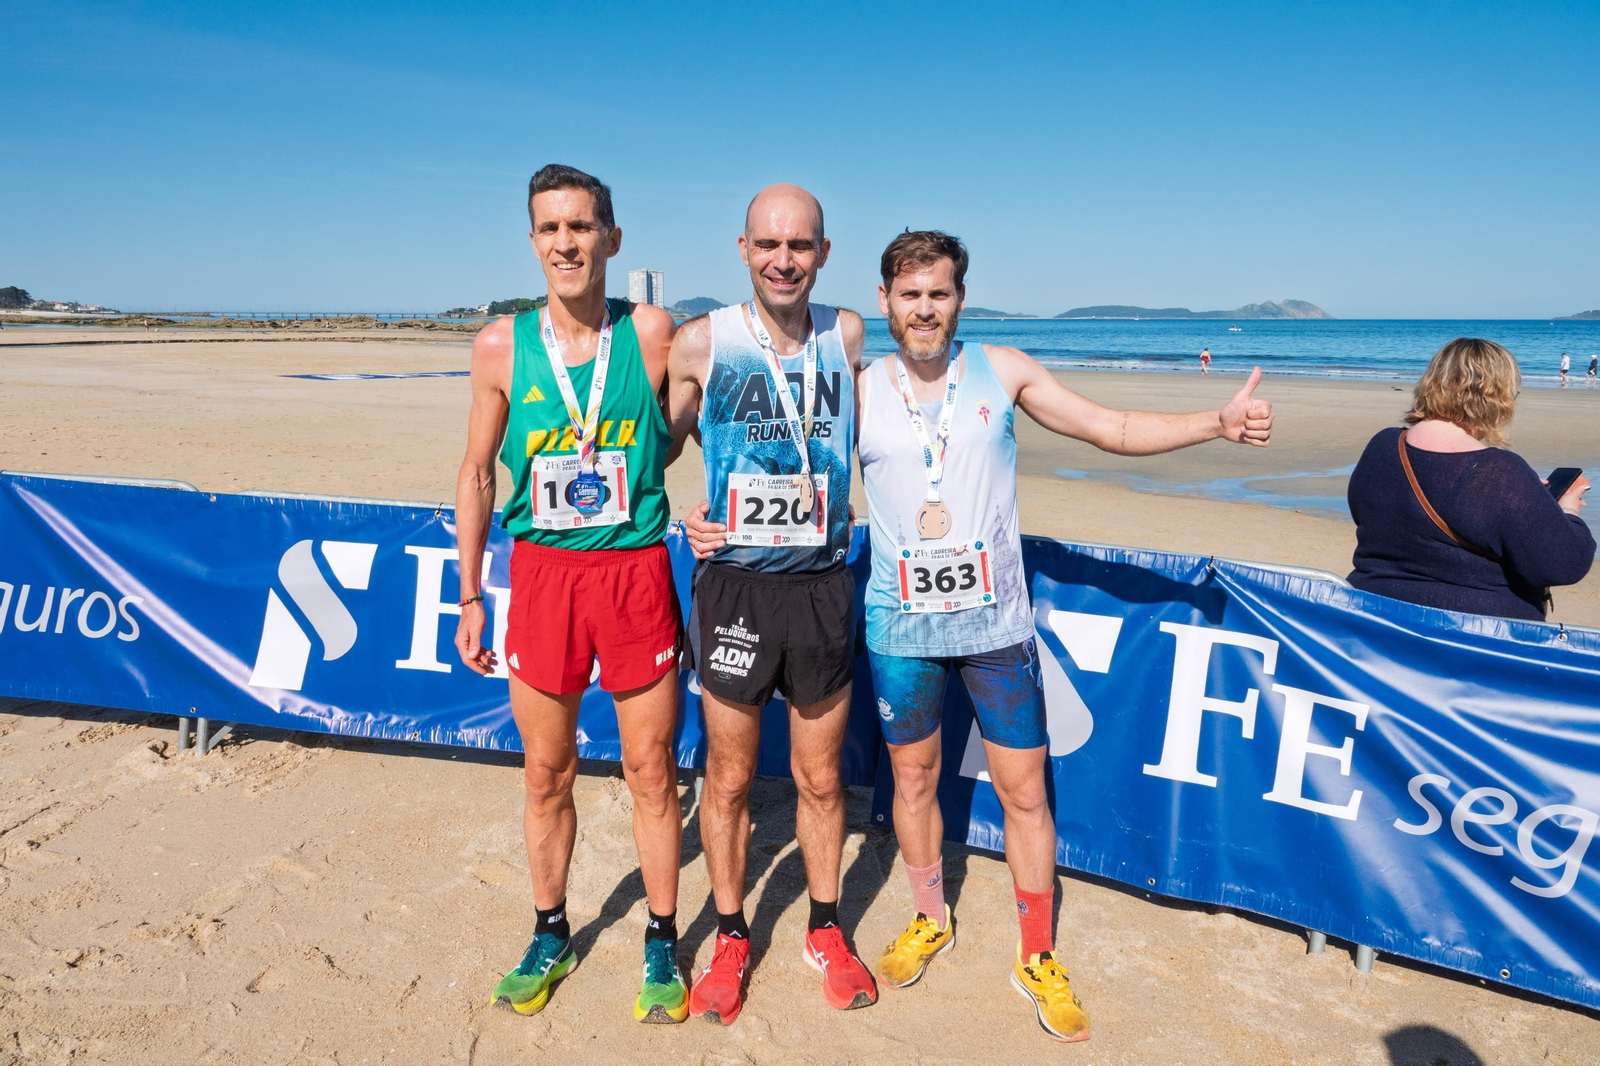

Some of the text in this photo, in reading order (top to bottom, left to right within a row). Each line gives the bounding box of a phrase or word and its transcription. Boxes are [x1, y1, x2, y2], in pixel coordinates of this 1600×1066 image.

[732, 371, 841, 423] ADN
[746, 421, 832, 442] RUNRS
[743, 496, 810, 526] 220
[913, 563, 977, 594] 363
[714, 625, 760, 643] PELUQUEROS
[709, 645, 756, 669] ADN
[710, 662, 748, 677] RUNNERS
[1143, 621, 1371, 821] FE
[1393, 773, 1600, 898] seg
